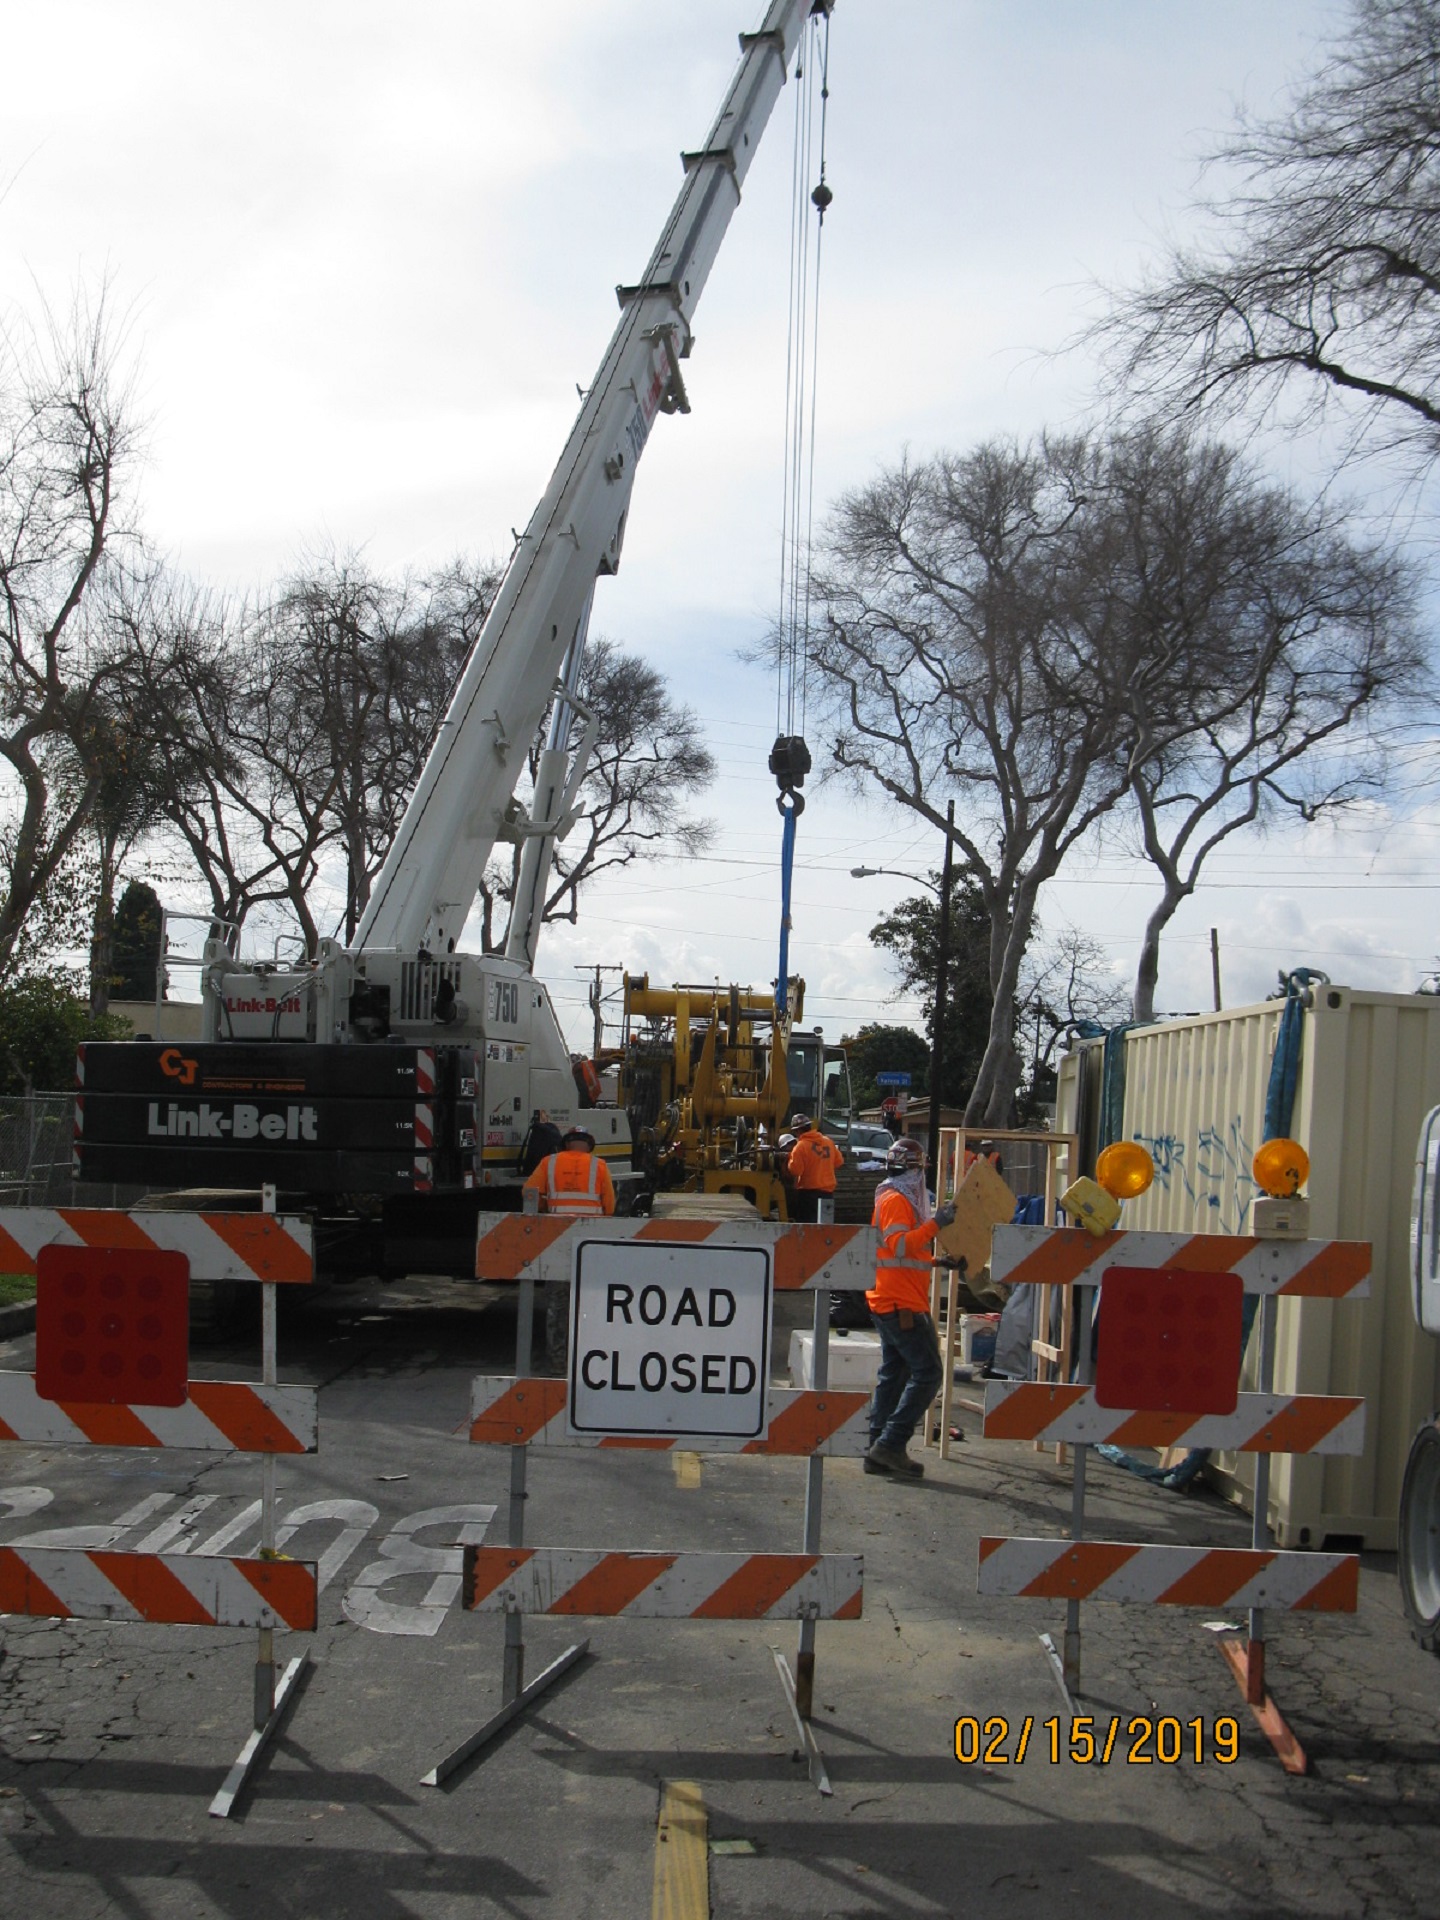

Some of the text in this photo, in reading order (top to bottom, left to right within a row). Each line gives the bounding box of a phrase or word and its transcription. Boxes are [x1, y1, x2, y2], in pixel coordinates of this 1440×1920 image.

[227, 997, 301, 1013] Link-Belt
[495, 981, 518, 1025] 750
[202, 1081, 253, 1090] CONTRACTORS
[148, 1102, 318, 1141] Link-Belt
[489, 1115, 513, 1127] Link-Belt
[606, 1283, 737, 1328] ROAD
[581, 1349, 757, 1395] CLOSED
